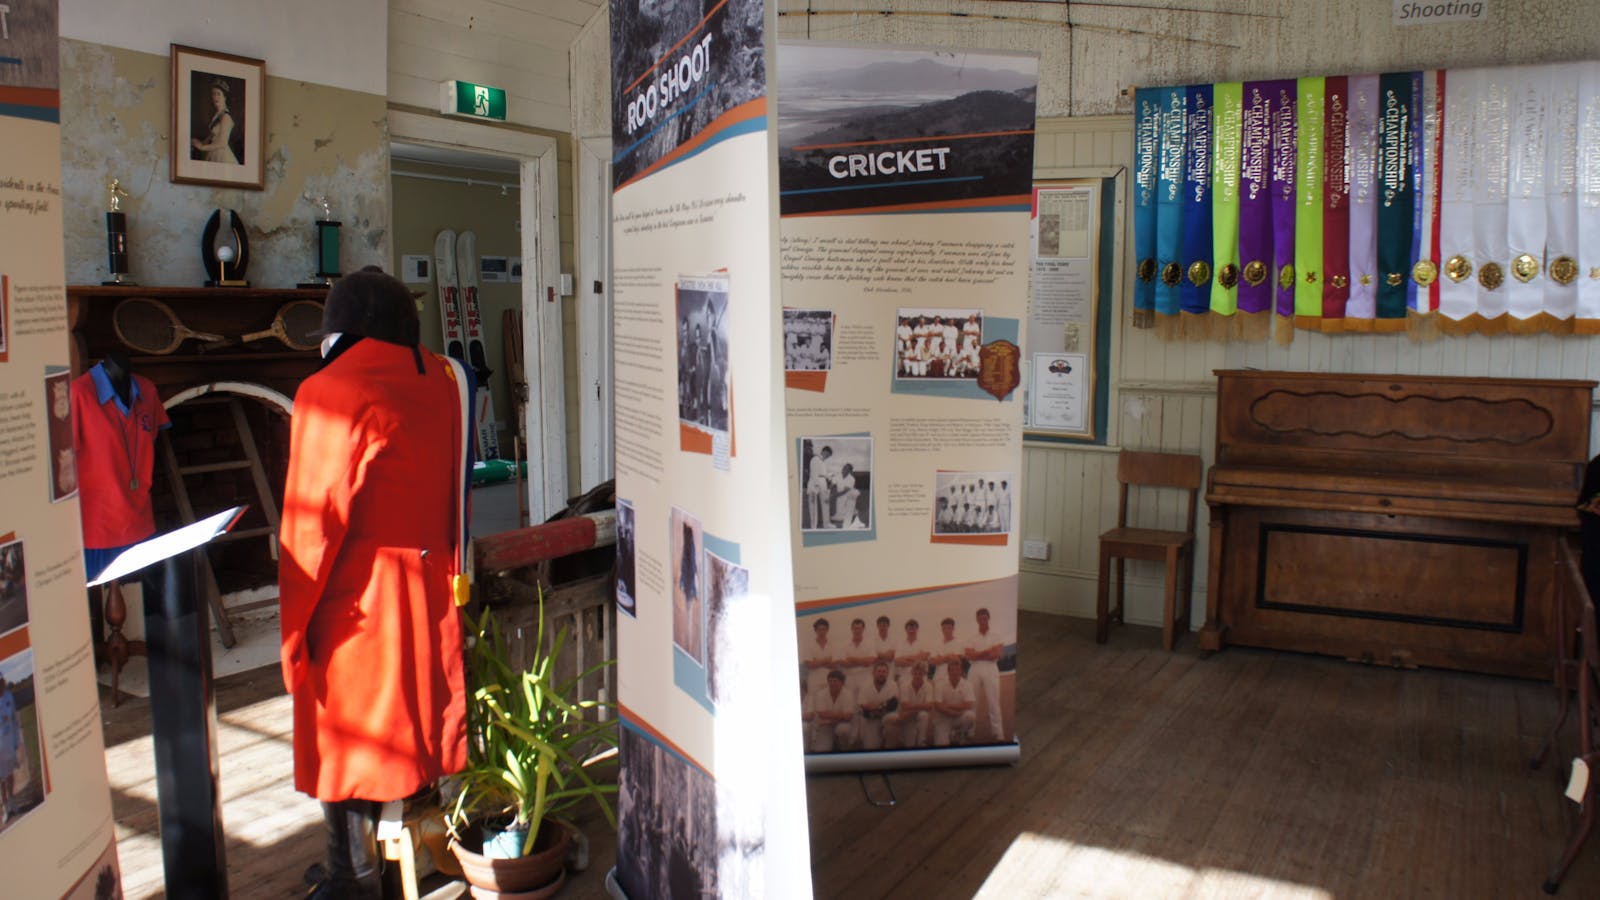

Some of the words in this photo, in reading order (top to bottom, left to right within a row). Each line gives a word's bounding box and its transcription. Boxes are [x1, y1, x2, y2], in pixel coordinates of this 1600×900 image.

[1400, 0, 1484, 19] Shooting
[627, 84, 657, 135] ROO
[660, 32, 713, 108] SHOOT
[828, 147, 950, 179] CRICKET
[1141, 116, 1153, 190] CHAMPIONSHIP
[1168, 108, 1181, 184] CHAMPIONSHIP
[1195, 109, 1207, 185] CHAMPIONSHIP
[1223, 110, 1235, 186] CHAMPIONSHIP
[1251, 105, 1263, 183] CHAMPIONSHIP
[1280, 106, 1292, 184] CHAMPIONSHIP
[1331, 112, 1344, 191] CHAMPIONSHIP
[1358, 107, 1369, 188] PIONSHIP
[1384, 108, 1399, 189] CHAMPIONSHIP
